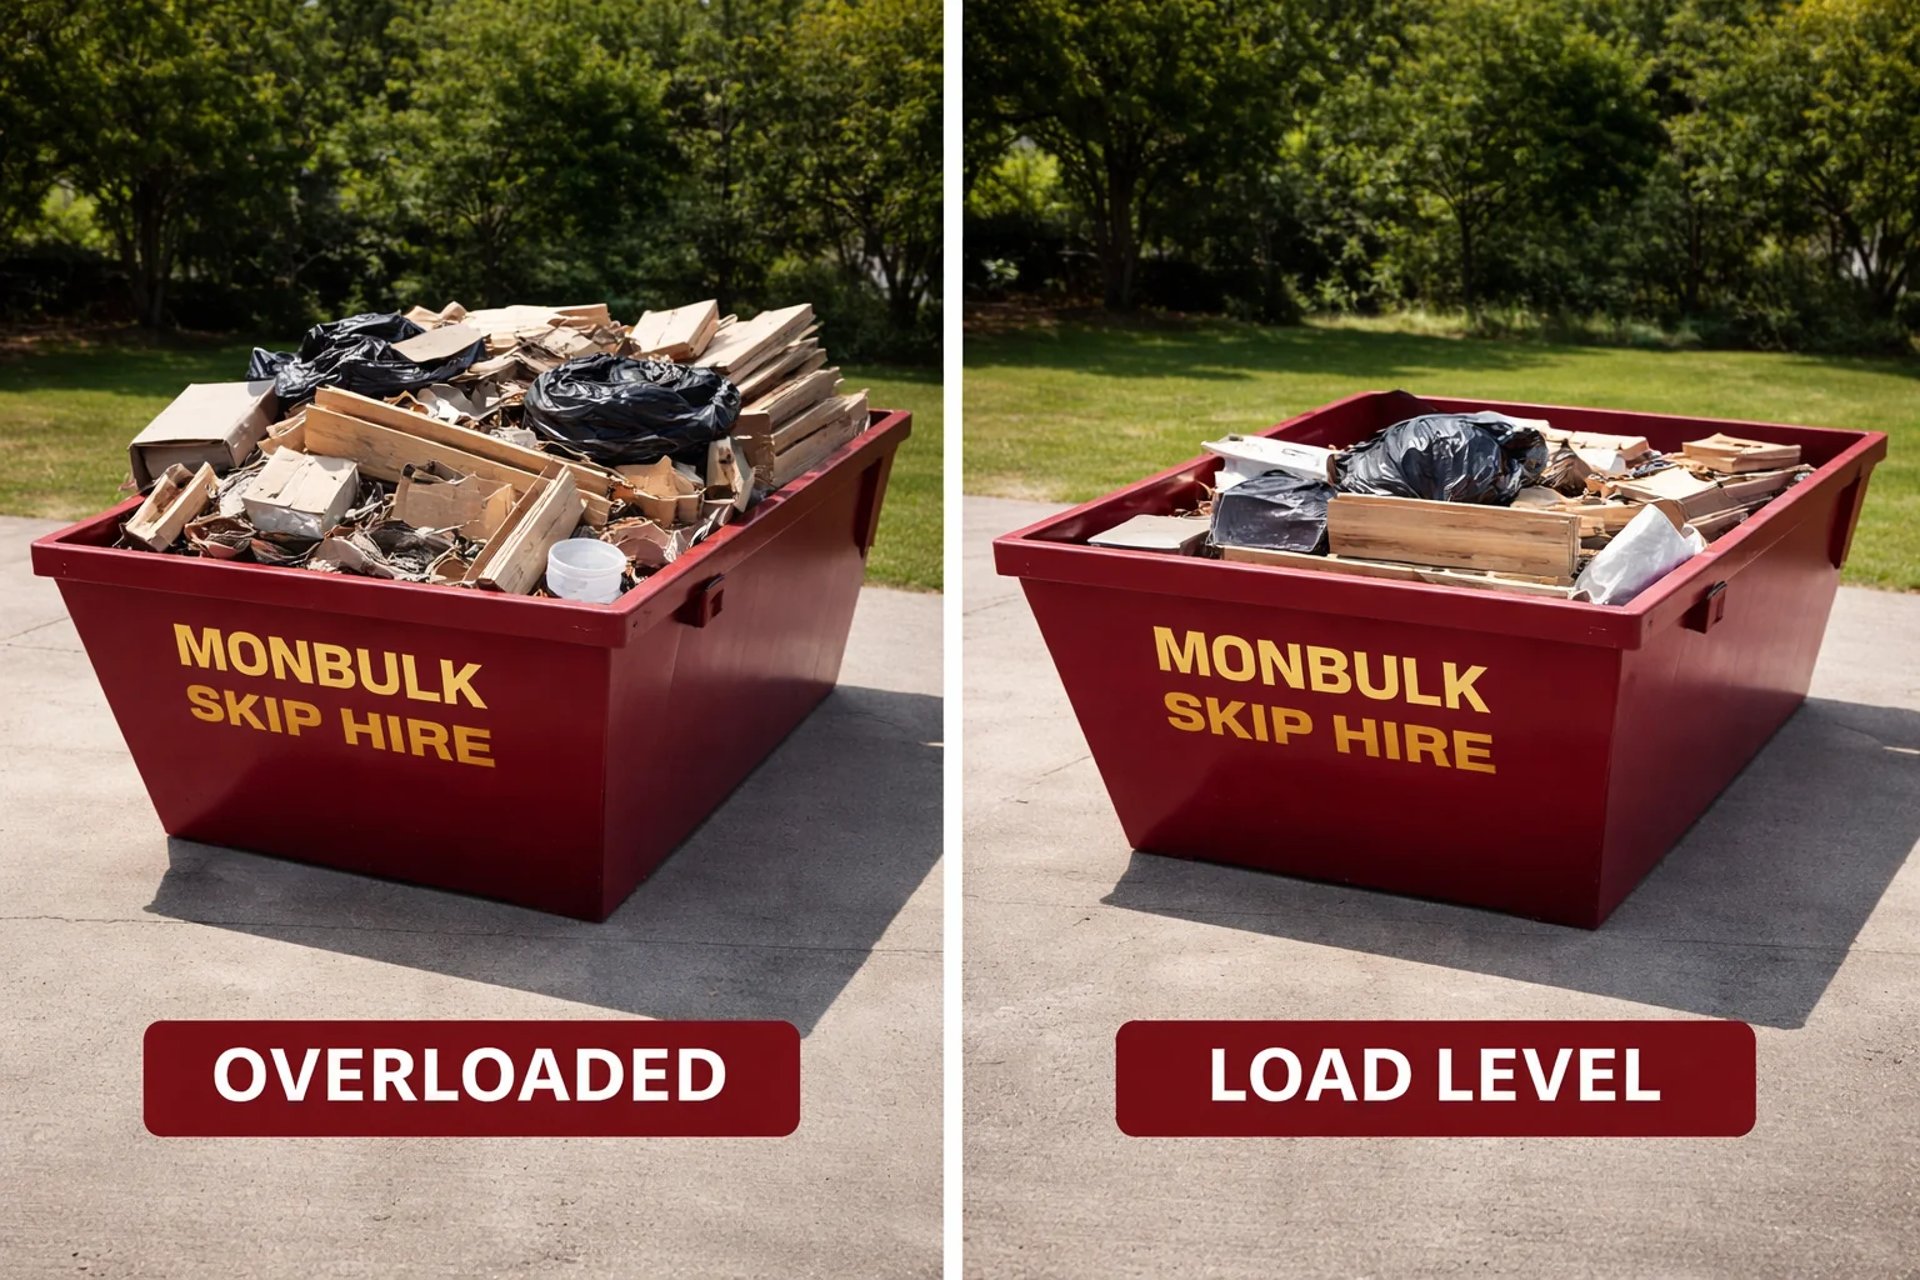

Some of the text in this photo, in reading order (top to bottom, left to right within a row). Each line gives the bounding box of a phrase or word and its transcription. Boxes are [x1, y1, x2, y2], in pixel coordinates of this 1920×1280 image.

[174, 623, 486, 709] MONBULK
[1153, 626, 1490, 713] MONBULK
[187, 685, 494, 768] SKIP HIRE
[1164, 692, 1495, 773] SKIP HIRE
